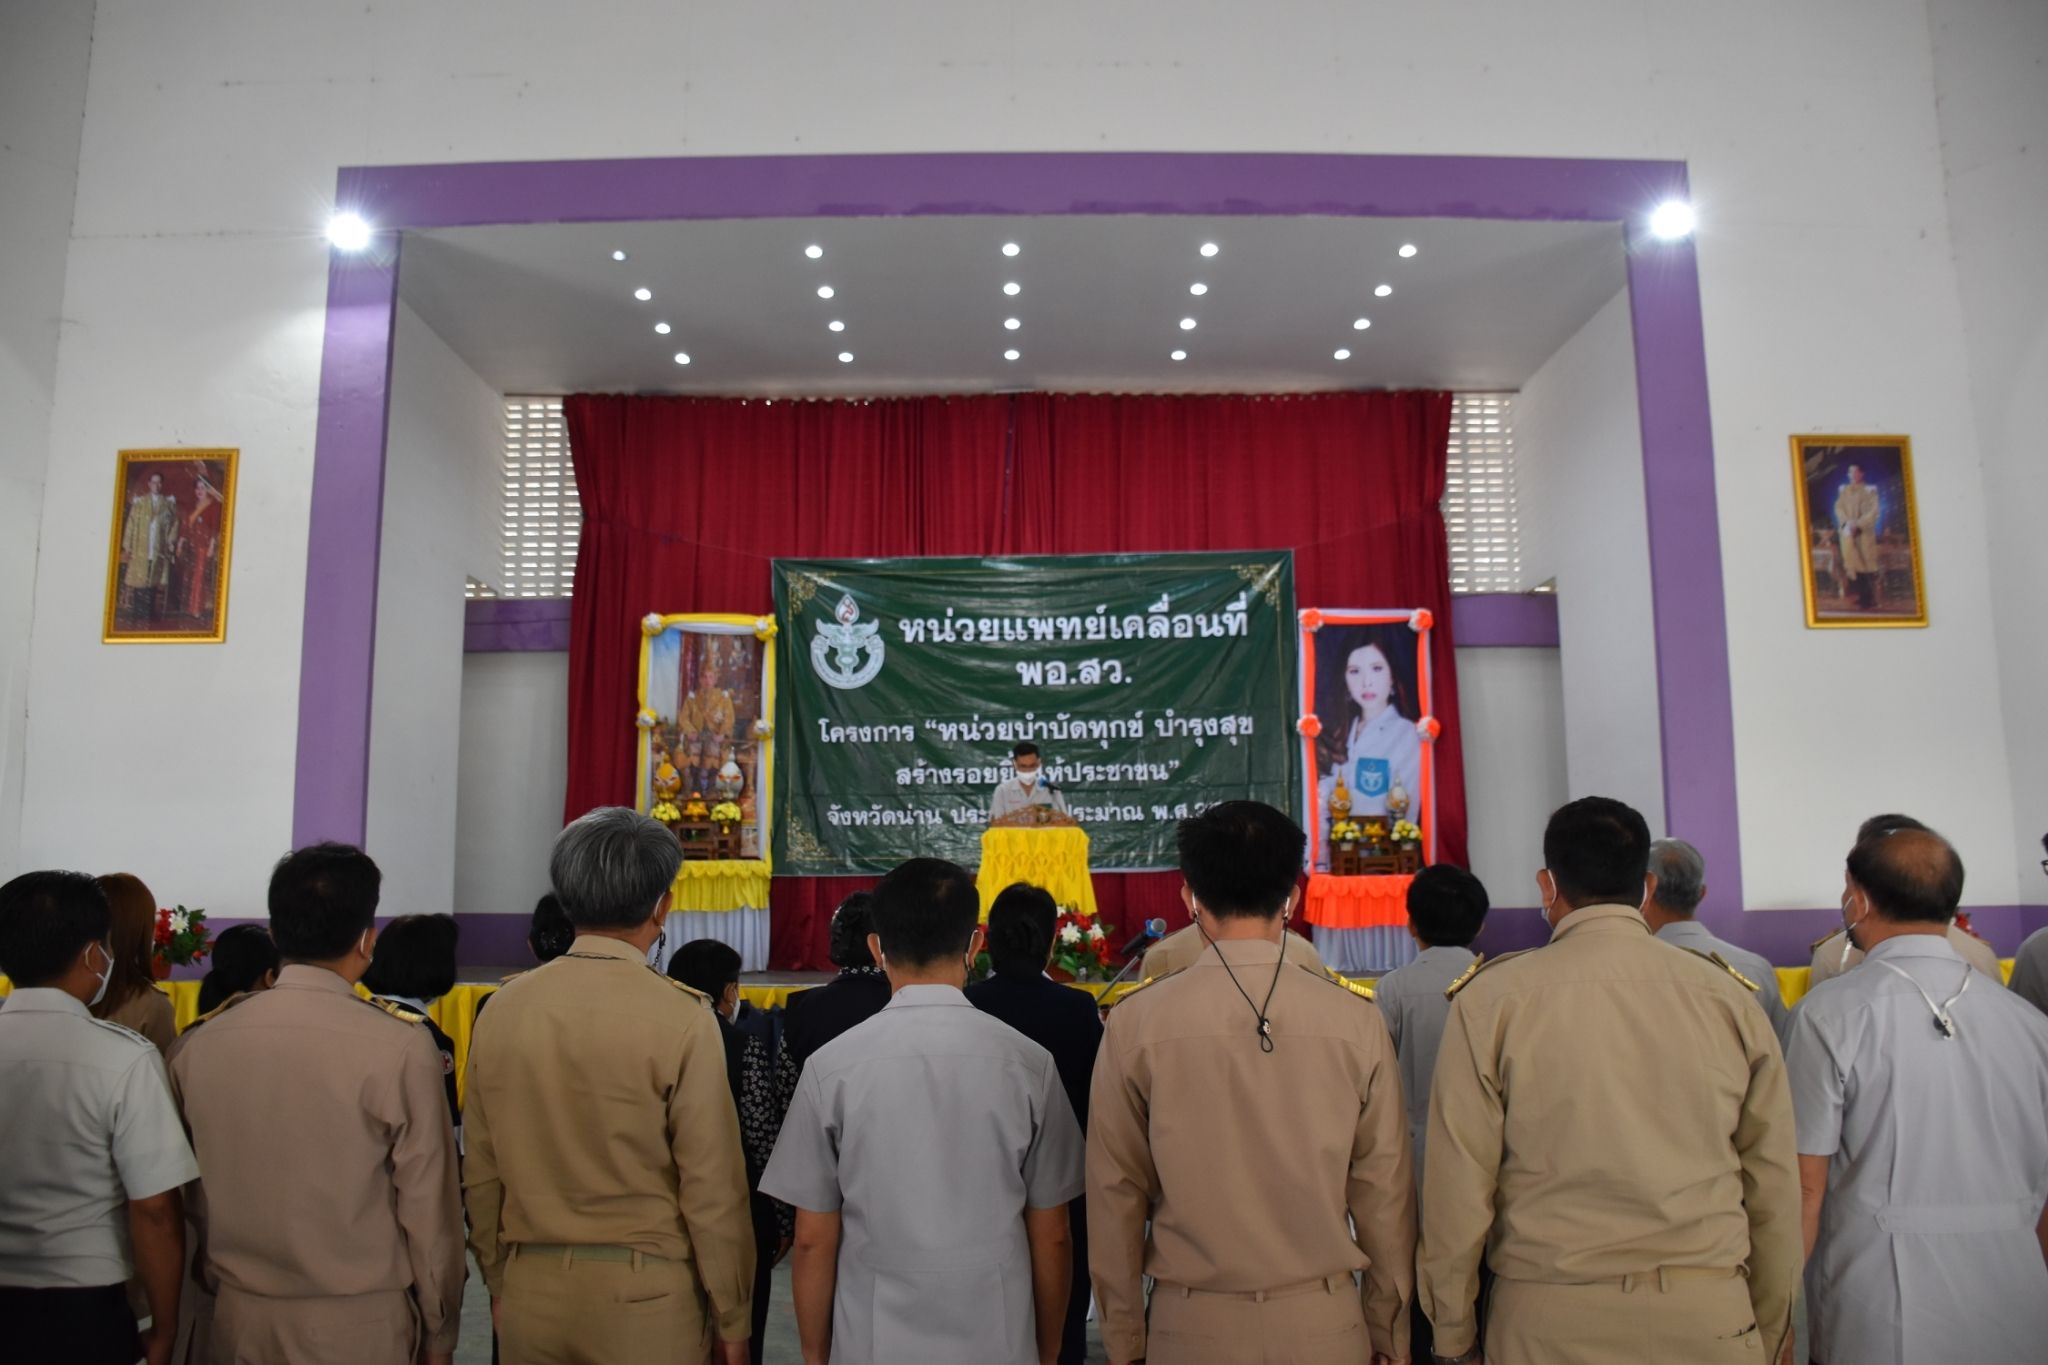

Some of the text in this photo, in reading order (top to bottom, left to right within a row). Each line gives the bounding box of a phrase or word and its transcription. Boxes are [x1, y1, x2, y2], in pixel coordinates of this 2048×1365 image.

[899, 592, 1247, 643] หน่วยแพทย์เคลื่อนที่
[1016, 658, 1132, 685] พอ.สว.
[818, 718, 914, 743] โครงการ
[1155, 709, 1253, 748] บำรุงสุข
[827, 804, 942, 826] จังหวัดน่าน
